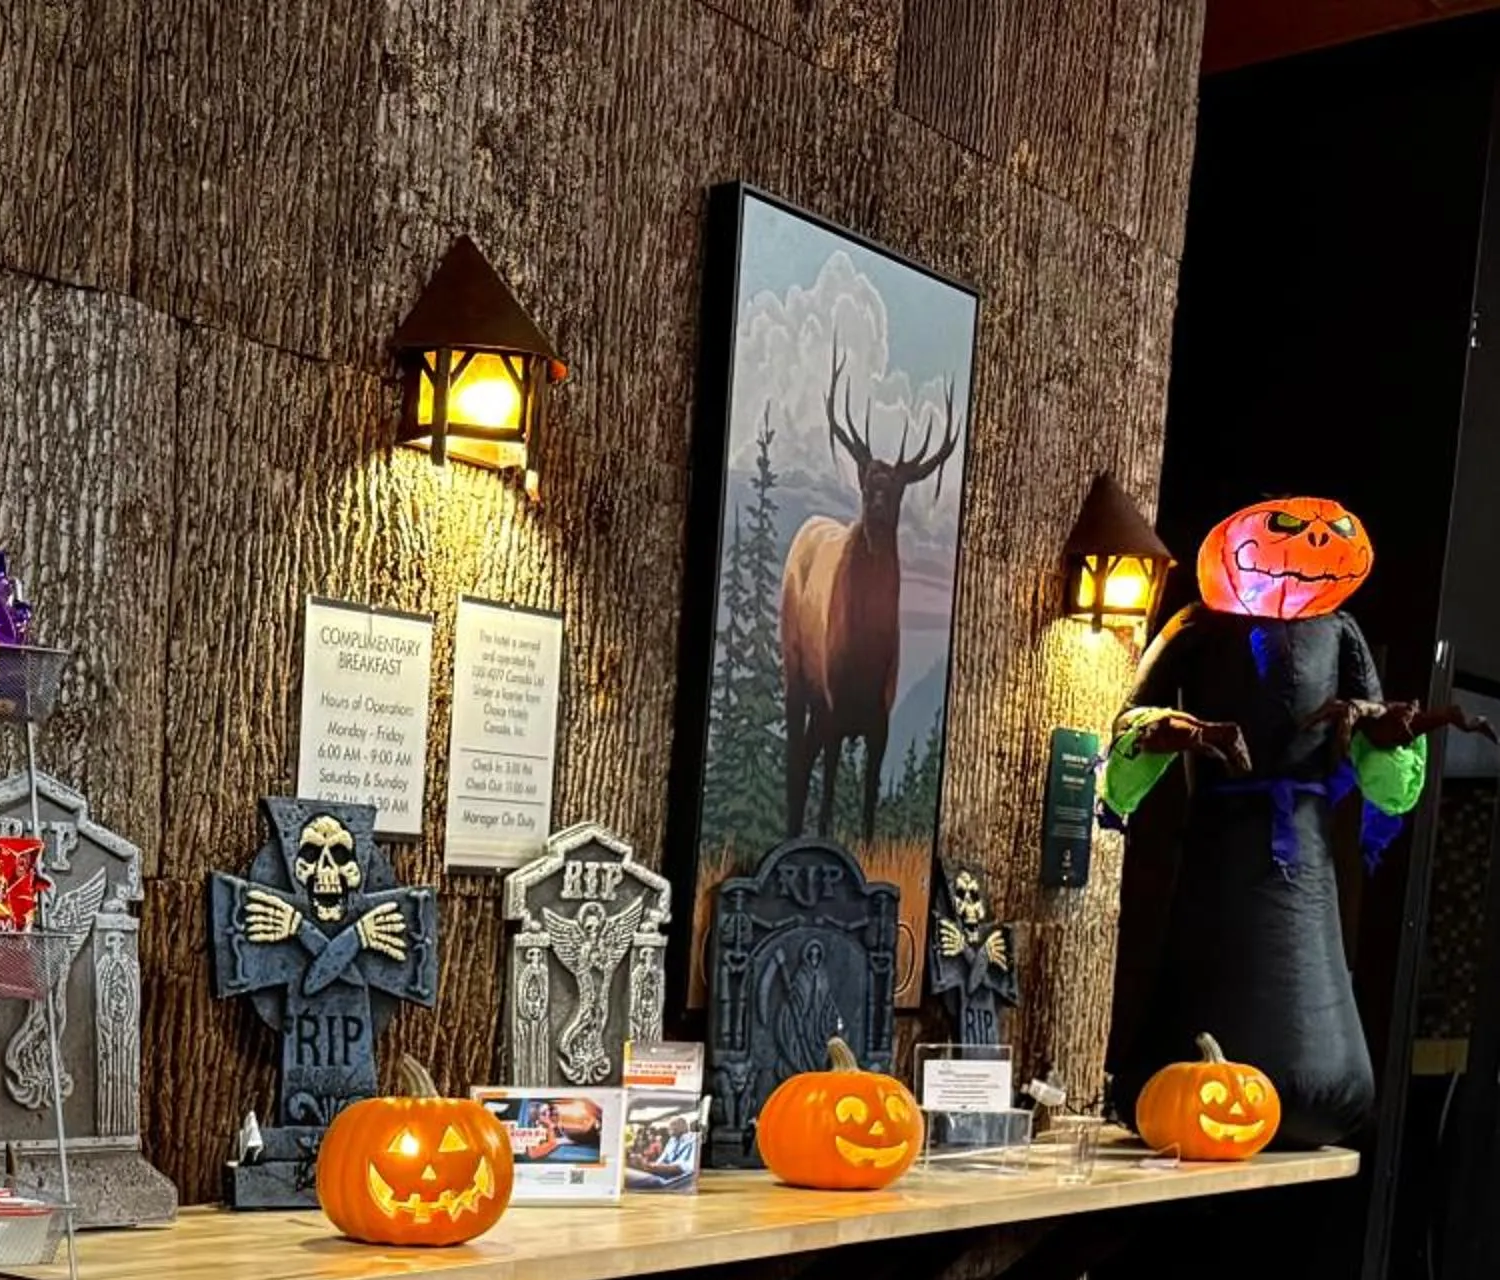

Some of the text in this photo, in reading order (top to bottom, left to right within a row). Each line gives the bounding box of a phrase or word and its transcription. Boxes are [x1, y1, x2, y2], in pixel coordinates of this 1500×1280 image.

[320, 625, 421, 657] COMPLIMENTARY
[339, 651, 402, 676] BREAKFAST
[321, 690, 349, 709] Hours
[351, 692, 363, 711] of
[327, 721, 366, 742] Monday
[377, 725, 405, 746] Friday
[318, 742, 340, 760] 6:00
[343, 746, 360, 761] AM
[370, 748, 392, 765] 9:00
[395, 750, 411, 767] AM
[319, 767, 409, 793] Saturday & Sunday
[392, 798, 409, 814] AM
[462, 808, 498, 830] Manager
[560, 860, 623, 900] RIP
[777, 863, 844, 908] RIP
[965, 1005, 993, 1044] RIP
[296, 1008, 365, 1067] RIP
